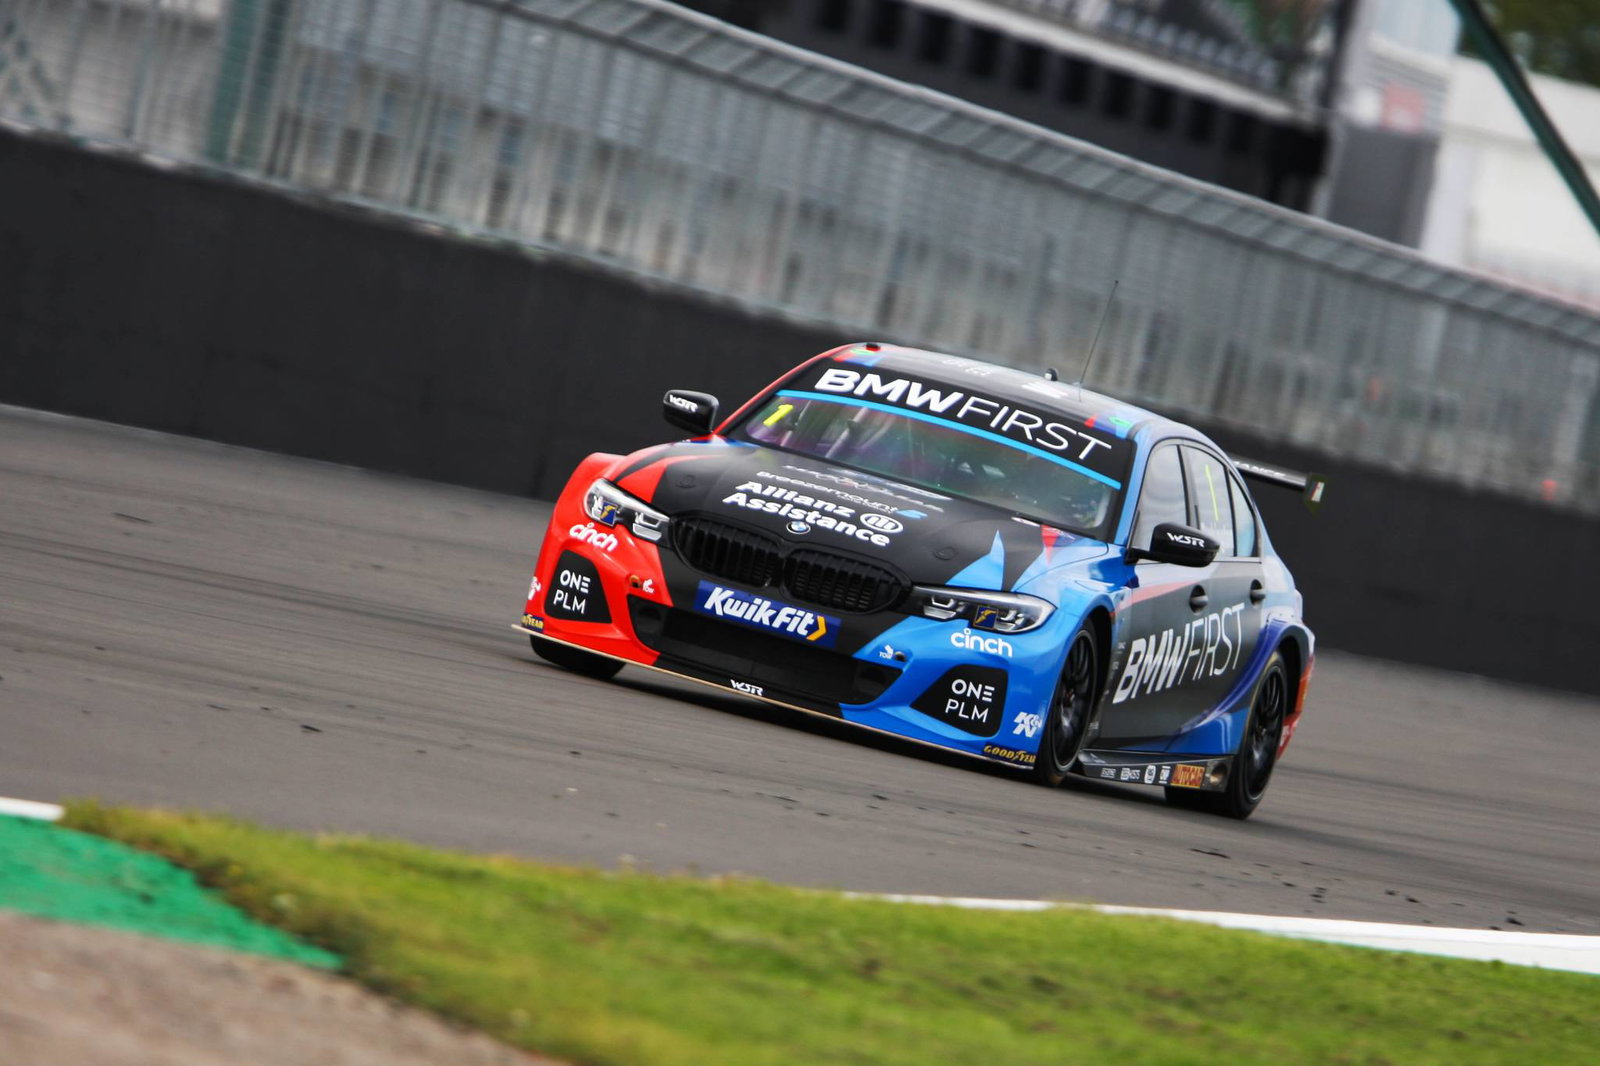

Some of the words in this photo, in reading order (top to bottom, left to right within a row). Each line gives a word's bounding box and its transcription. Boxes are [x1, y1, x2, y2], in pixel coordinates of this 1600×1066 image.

[763, 404, 794, 426] 1
[735, 481, 856, 518] Allianz
[722, 492, 890, 547] Assistance
[569, 522, 618, 552] cinch
[1166, 532, 1205, 548] WSR
[560, 569, 591, 594] ONE
[553, 589, 586, 614] PLM
[950, 628, 1013, 658] cinch
[730, 679, 763, 696] WSR
[951, 679, 995, 702] ONE
[945, 698, 989, 723] PLM
